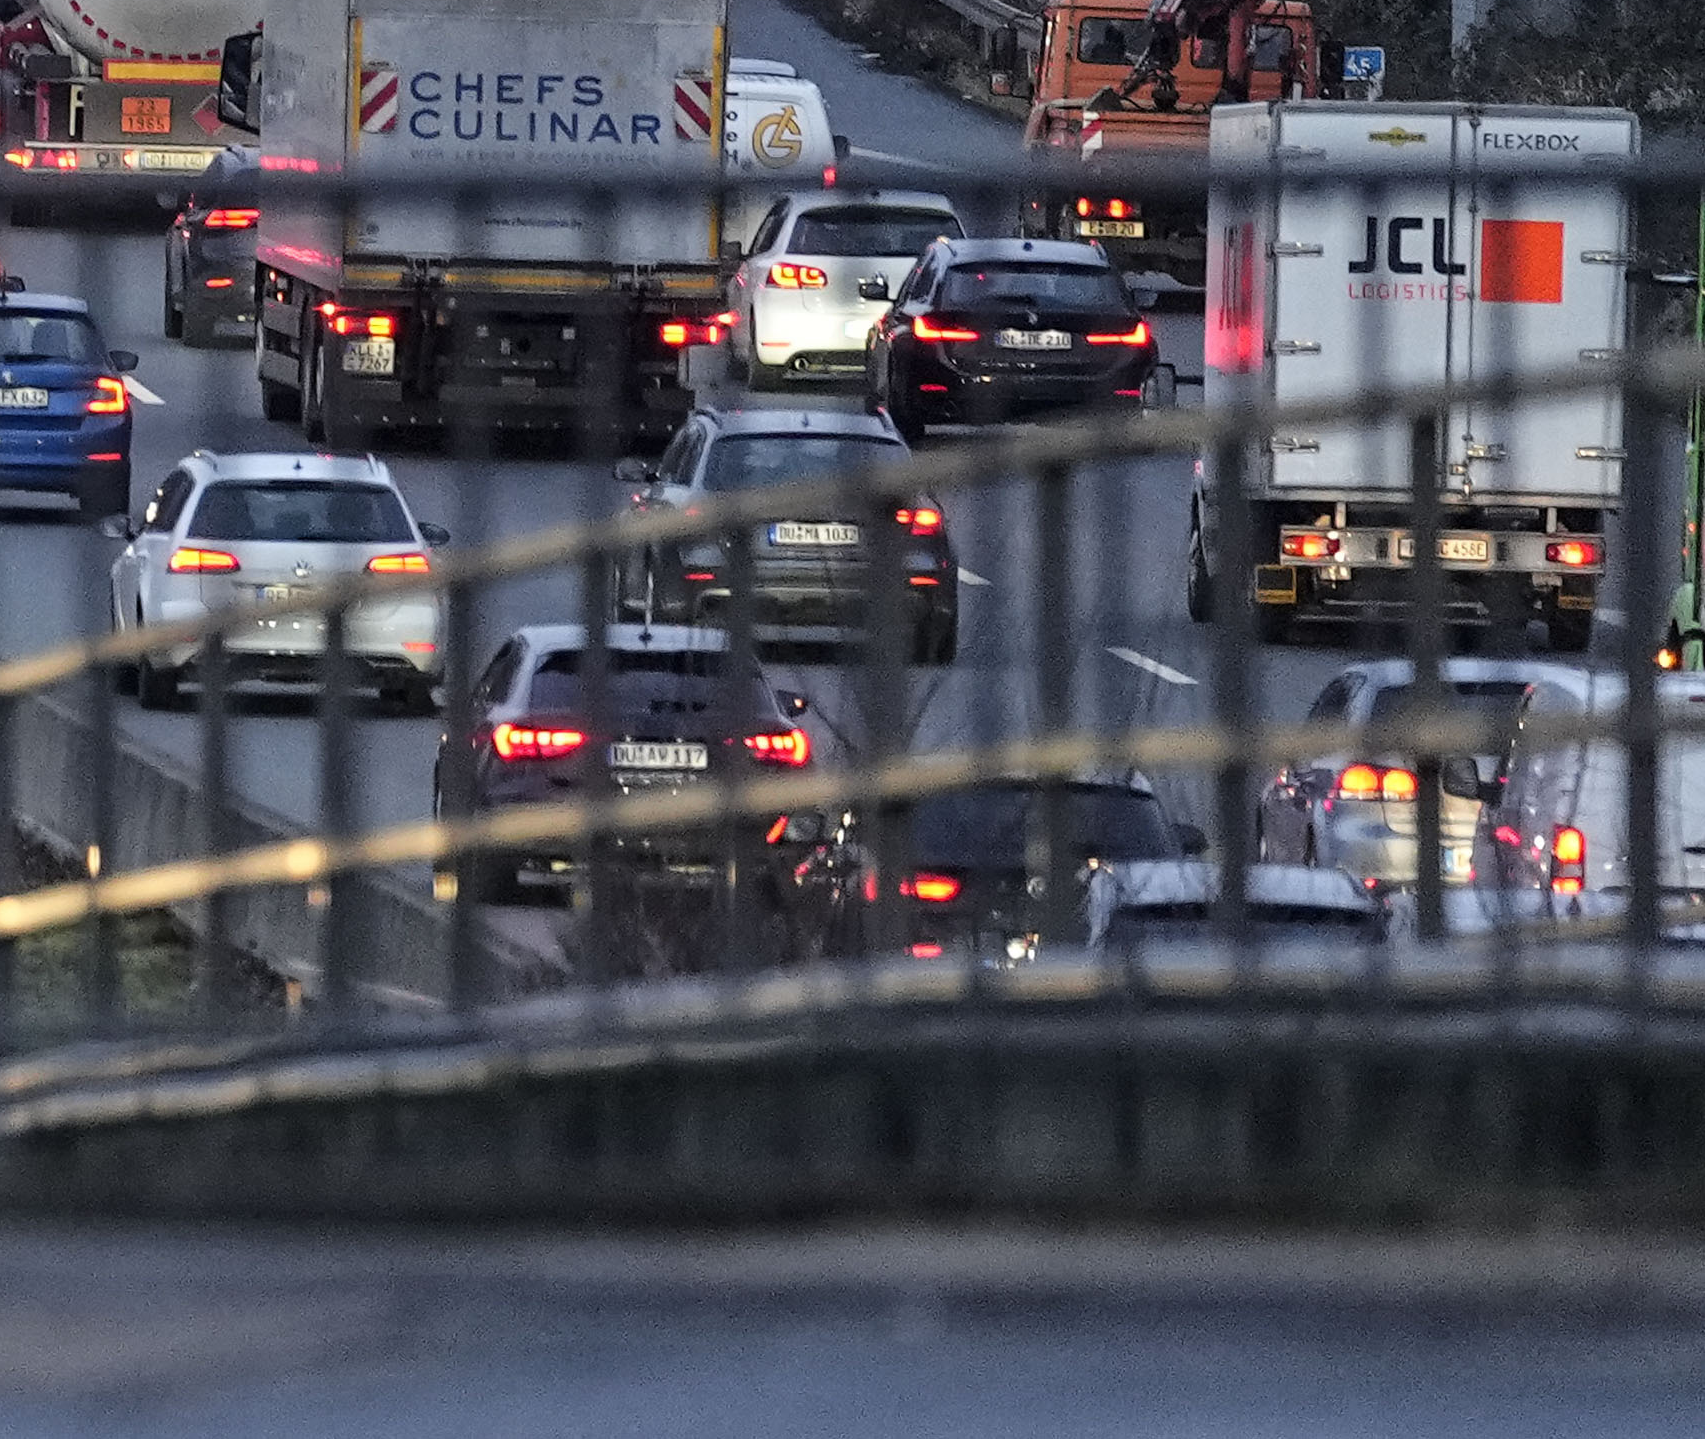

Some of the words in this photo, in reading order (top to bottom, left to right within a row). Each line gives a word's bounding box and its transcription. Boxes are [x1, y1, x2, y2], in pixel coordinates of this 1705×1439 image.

[409, 71, 604, 106] CHEFS
[137, 100, 155, 113] 23
[127, 116, 165, 131] 1965
[409, 108, 661, 145] CULINAR
[1483, 133, 1580, 151] FLEXBOX
[1348, 216, 1466, 276] JCL
[1348, 283, 1467, 302] LOGISTICS
